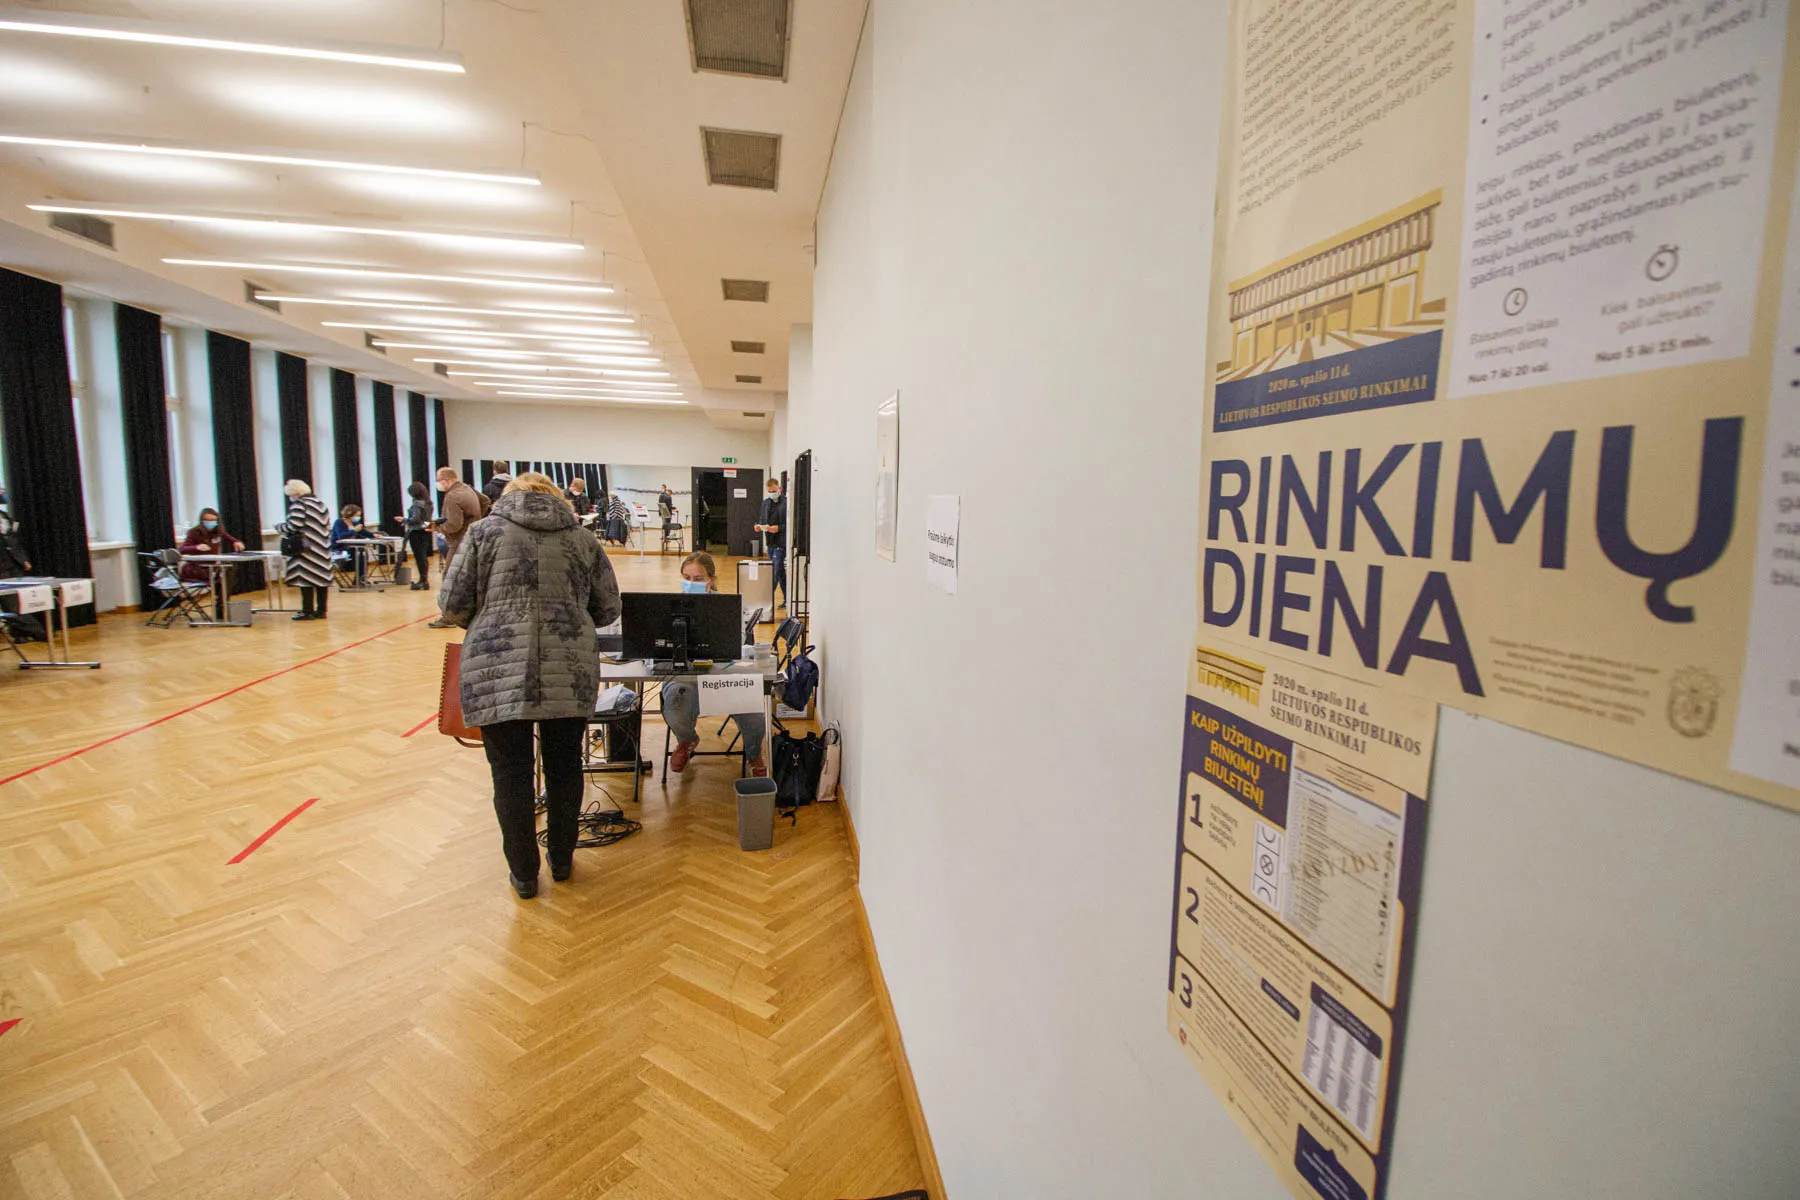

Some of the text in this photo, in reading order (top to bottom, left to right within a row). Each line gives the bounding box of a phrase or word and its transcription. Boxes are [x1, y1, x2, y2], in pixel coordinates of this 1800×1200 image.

[1468, 374, 1488, 383] Nuo
[1514, 365, 1529, 376] 20
[1595, 350, 1622, 363] Nuo
[1220, 374, 1428, 423] LIETUVOS RESPUBLIKOS SEIMO RINKIMAI
[1268, 379, 1288, 393] 2020
[1300, 371, 1328, 388] spalio
[1206, 416, 1745, 624] RINKIMŲ
[1203, 548, 1487, 697] DIENA
[702, 678, 754, 690] Registracija
[1272, 673, 1295, 691] 2020
[1311, 688, 1343, 707] spalio
[1346, 697, 1356, 712] 11
[1191, 711, 1288, 772] KAIP UŽPILDYTI
[1270, 706, 1366, 754] SEIMO RINKIMAI
[1271, 689, 1422, 756] LIETUVOS RESPUBLIKOS
[1210, 740, 1260, 781] RINKIMŲ
[1204, 758, 1265, 810] BIULETENĮ
[1190, 794, 1203, 828] 1
[1186, 887, 1199, 925] 2
[1179, 972, 1193, 1009] 3
